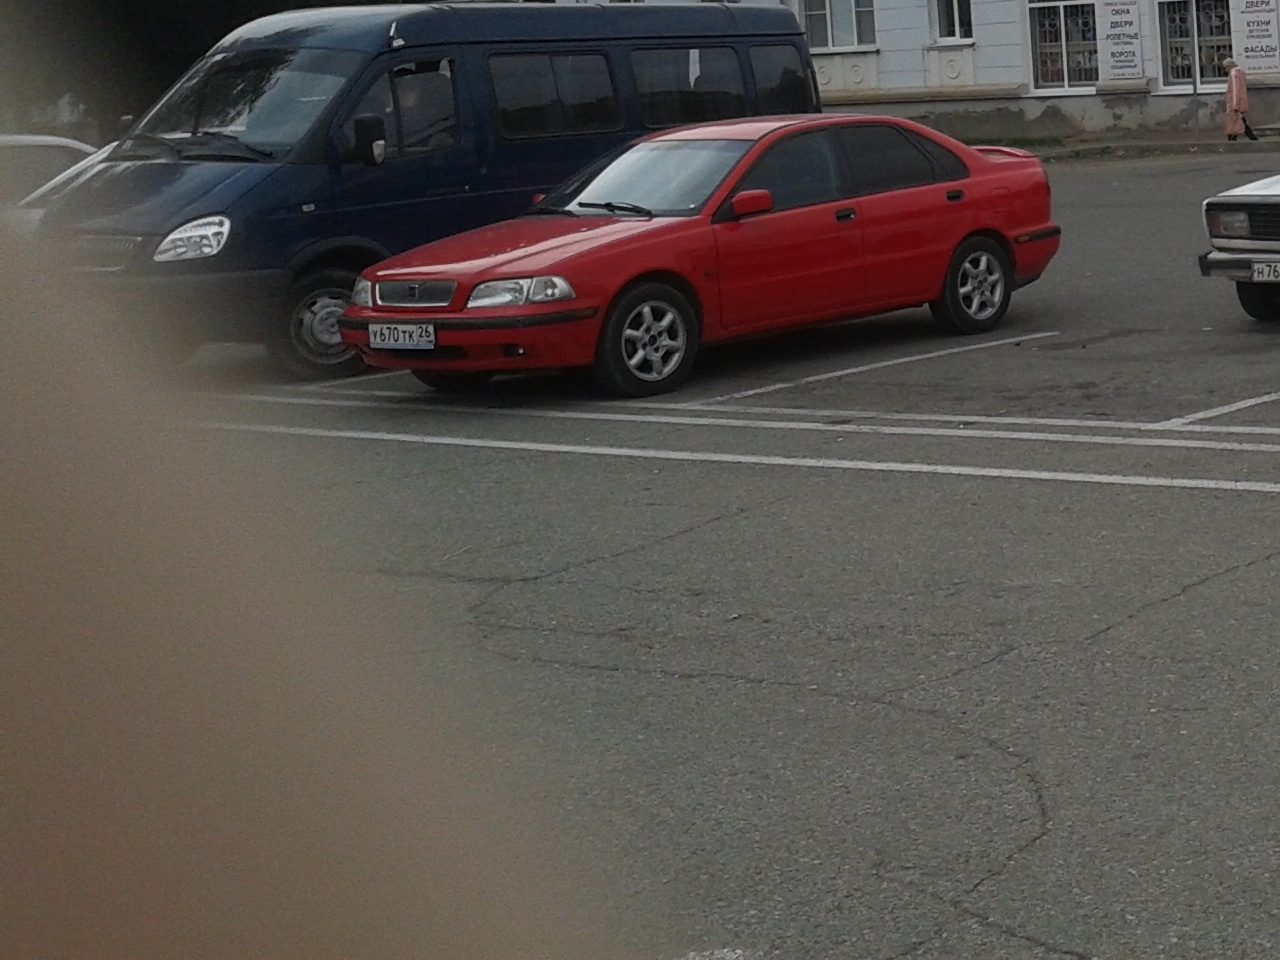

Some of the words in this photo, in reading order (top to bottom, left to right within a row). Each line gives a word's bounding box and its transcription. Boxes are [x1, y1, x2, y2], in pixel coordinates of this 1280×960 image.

[1244, 0, 1271, 9] ДВЕРИ
[1111, 8, 1131, 16] ОКНА
[1110, 20, 1134, 30] ДВЕРИ
[1246, 19, 1271, 28] КУХНИ
[1243, 44, 1278, 55] ФАСАДЫ
[1110, 50, 1138, 59] ВОРОТА
